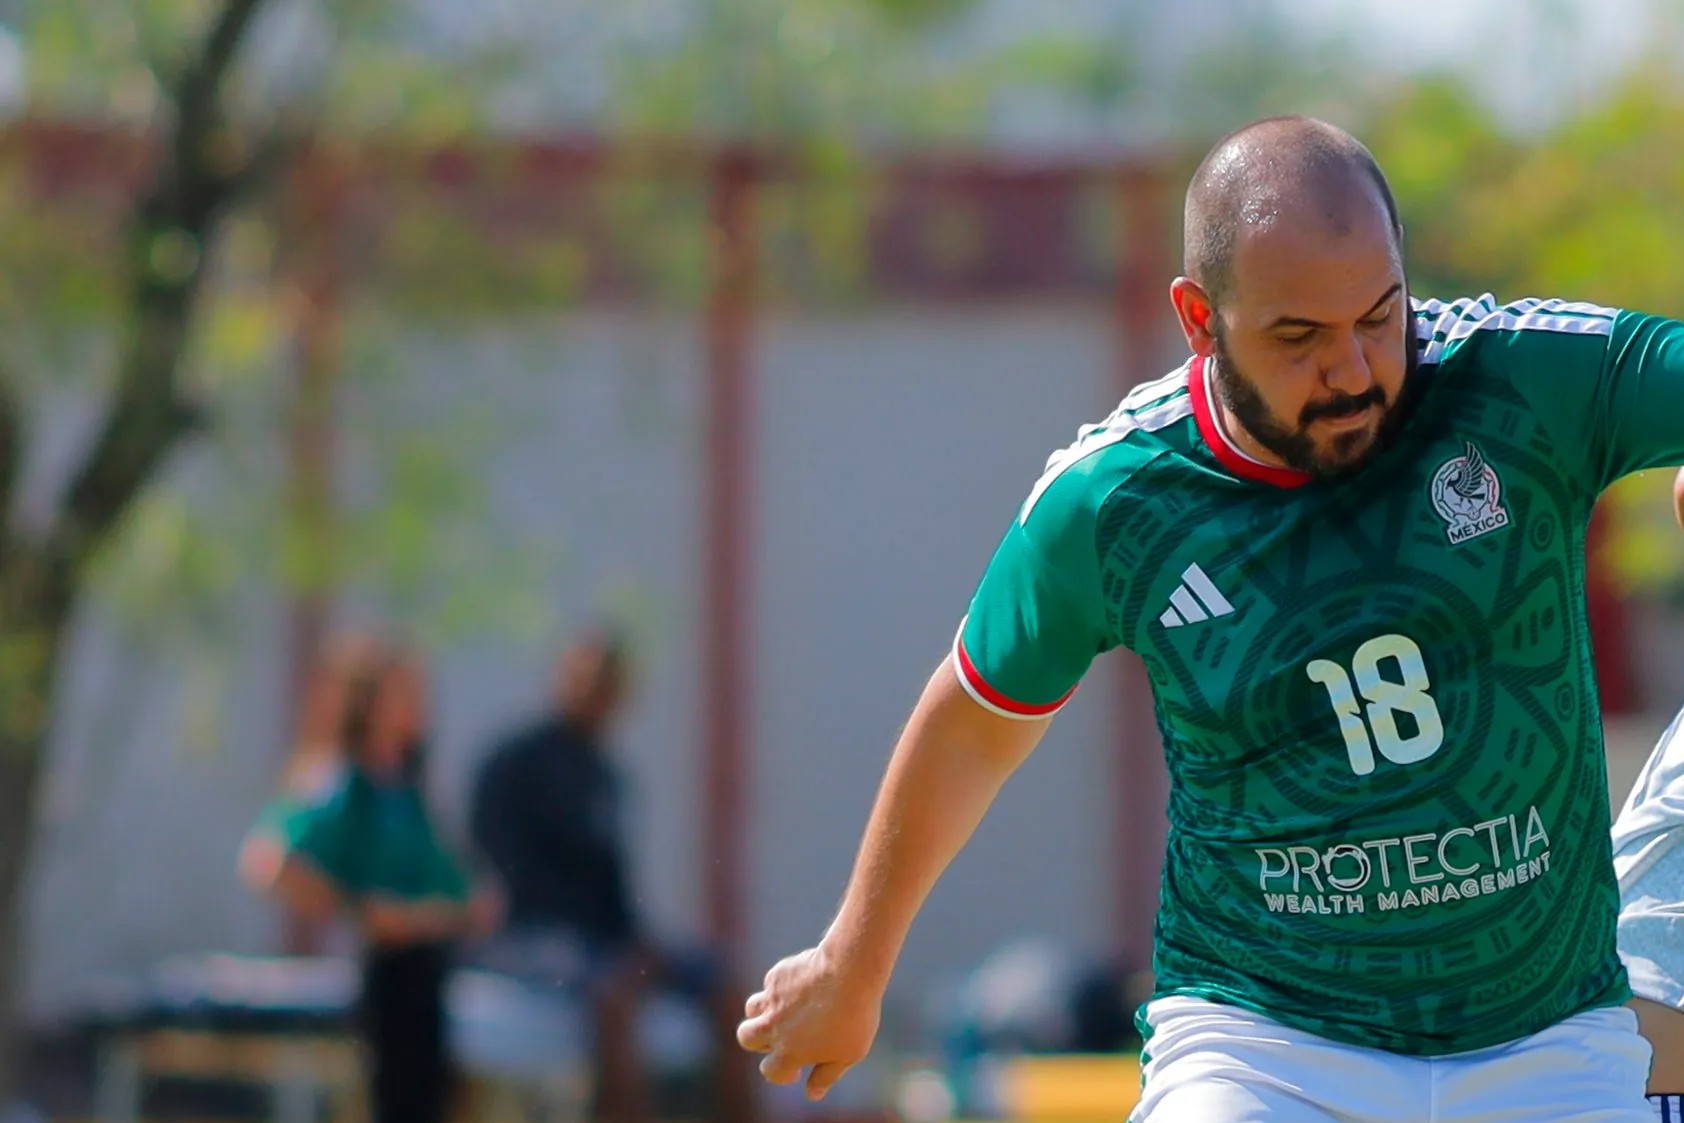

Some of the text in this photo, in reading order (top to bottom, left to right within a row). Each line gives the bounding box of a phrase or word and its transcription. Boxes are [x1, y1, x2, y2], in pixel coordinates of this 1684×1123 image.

[1450, 512, 1505, 542] MÉXICO
[1306, 634, 1444, 775] 18
[1255, 805, 1550, 893] PROTECTIA
[1264, 850, 1551, 915] WEALTH MANAGEMENT
